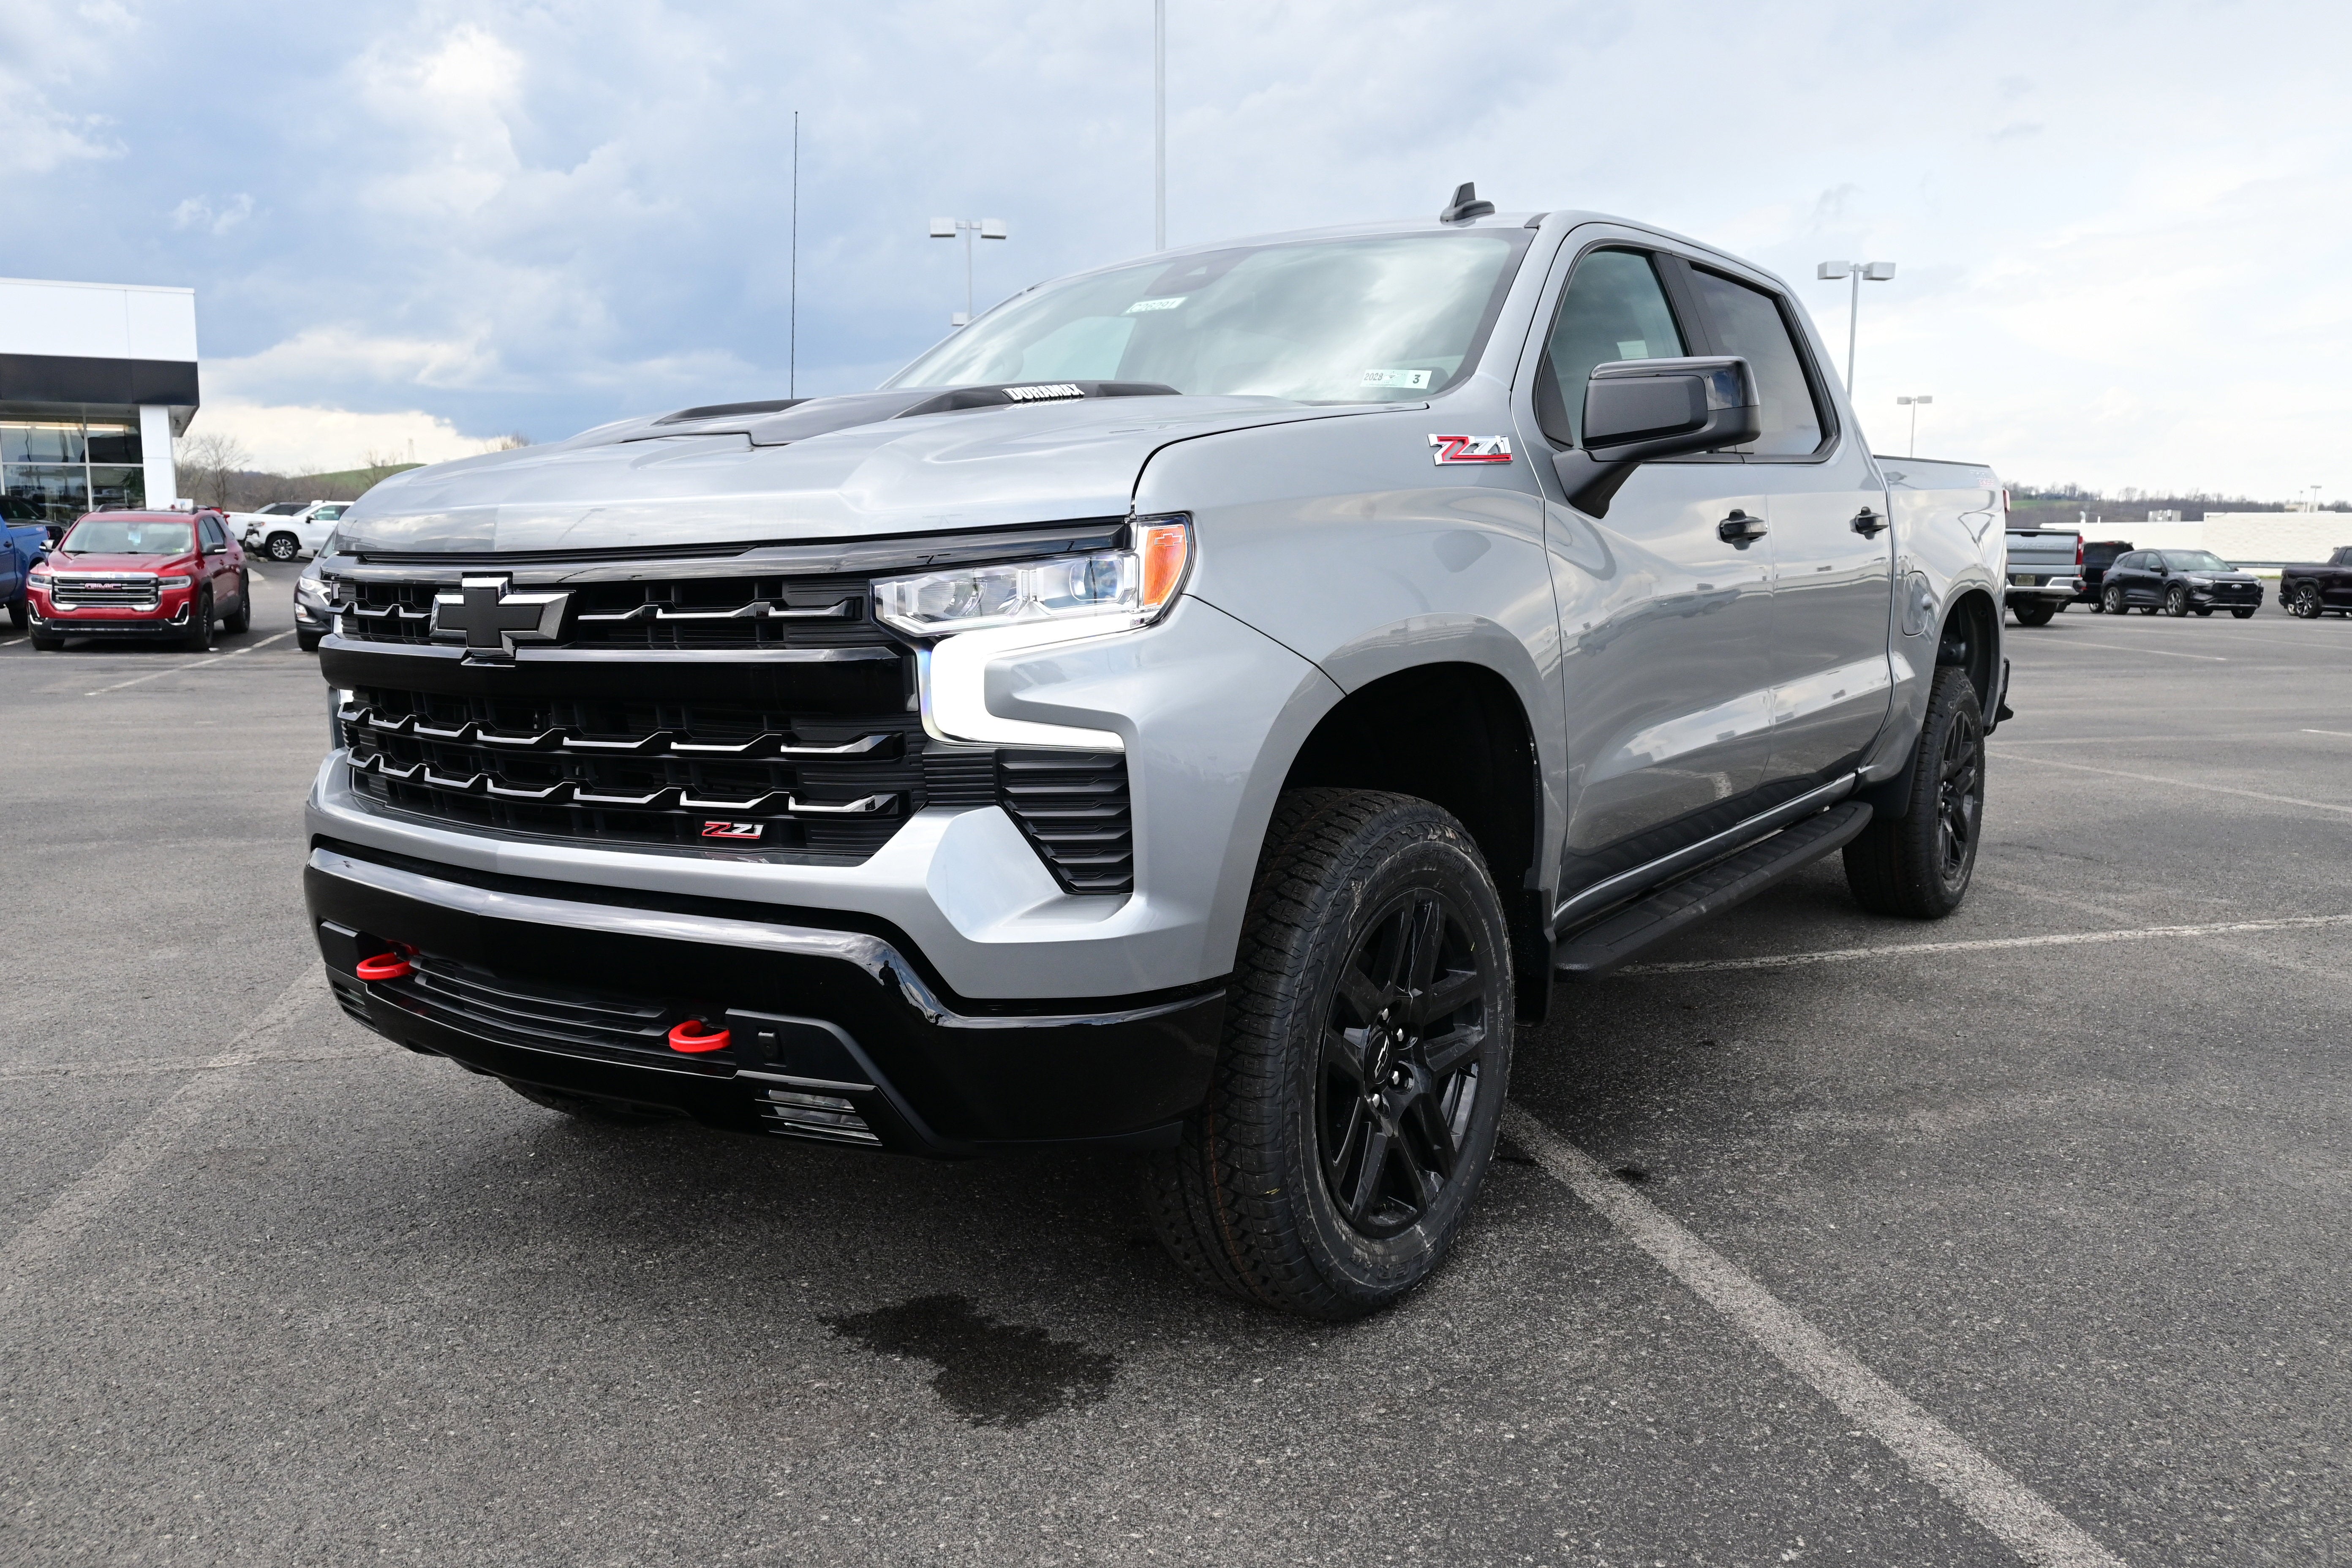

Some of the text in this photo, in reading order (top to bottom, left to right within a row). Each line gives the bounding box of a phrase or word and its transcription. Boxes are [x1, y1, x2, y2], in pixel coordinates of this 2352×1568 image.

[1364, 373, 1421, 384] 2028 3
[1002, 384, 1085, 402] DURAMAX
[1428, 433, 1514, 466] Z71
[702, 821, 764, 839] Z71
